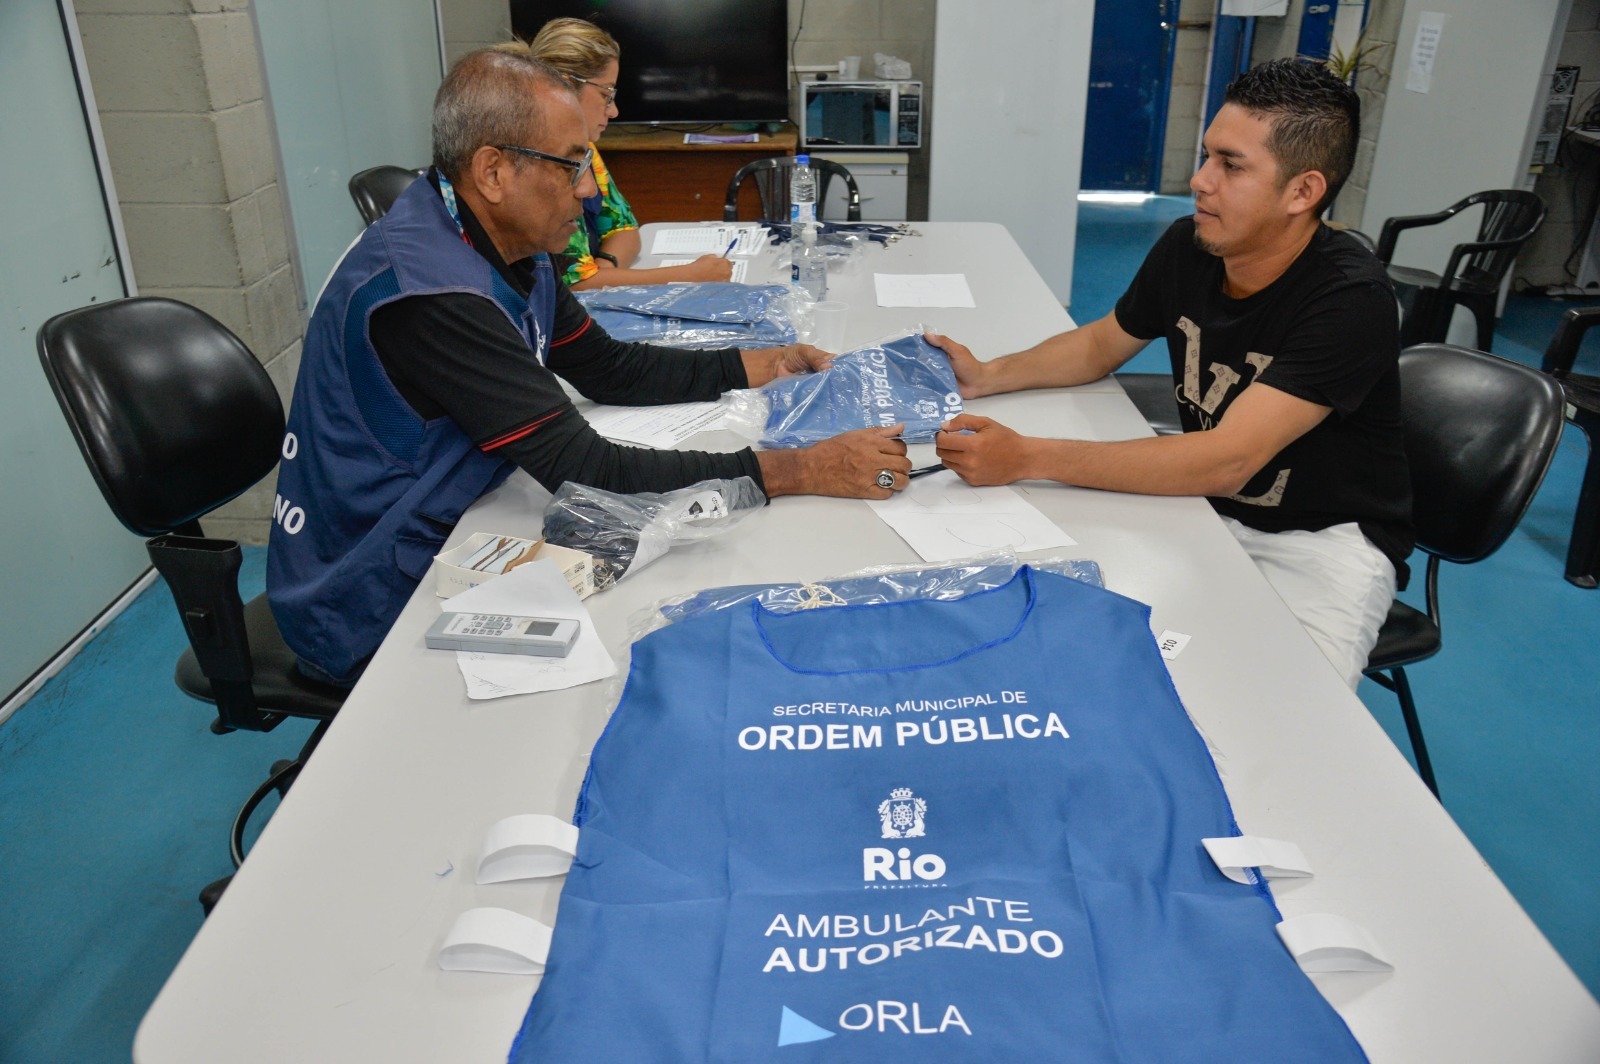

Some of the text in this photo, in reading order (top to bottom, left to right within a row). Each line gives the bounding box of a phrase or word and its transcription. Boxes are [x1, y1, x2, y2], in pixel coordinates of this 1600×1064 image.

[773, 690, 1028, 717] SECRETARIA MUNICIPAL DE
[737, 712, 1070, 751] ORDEM PÚBLICA
[863, 847, 946, 881] Rio
[764, 896, 1034, 939] AMBULANTE
[762, 925, 1064, 973] AUTORIZADO
[838, 1000, 972, 1036] ORLA
